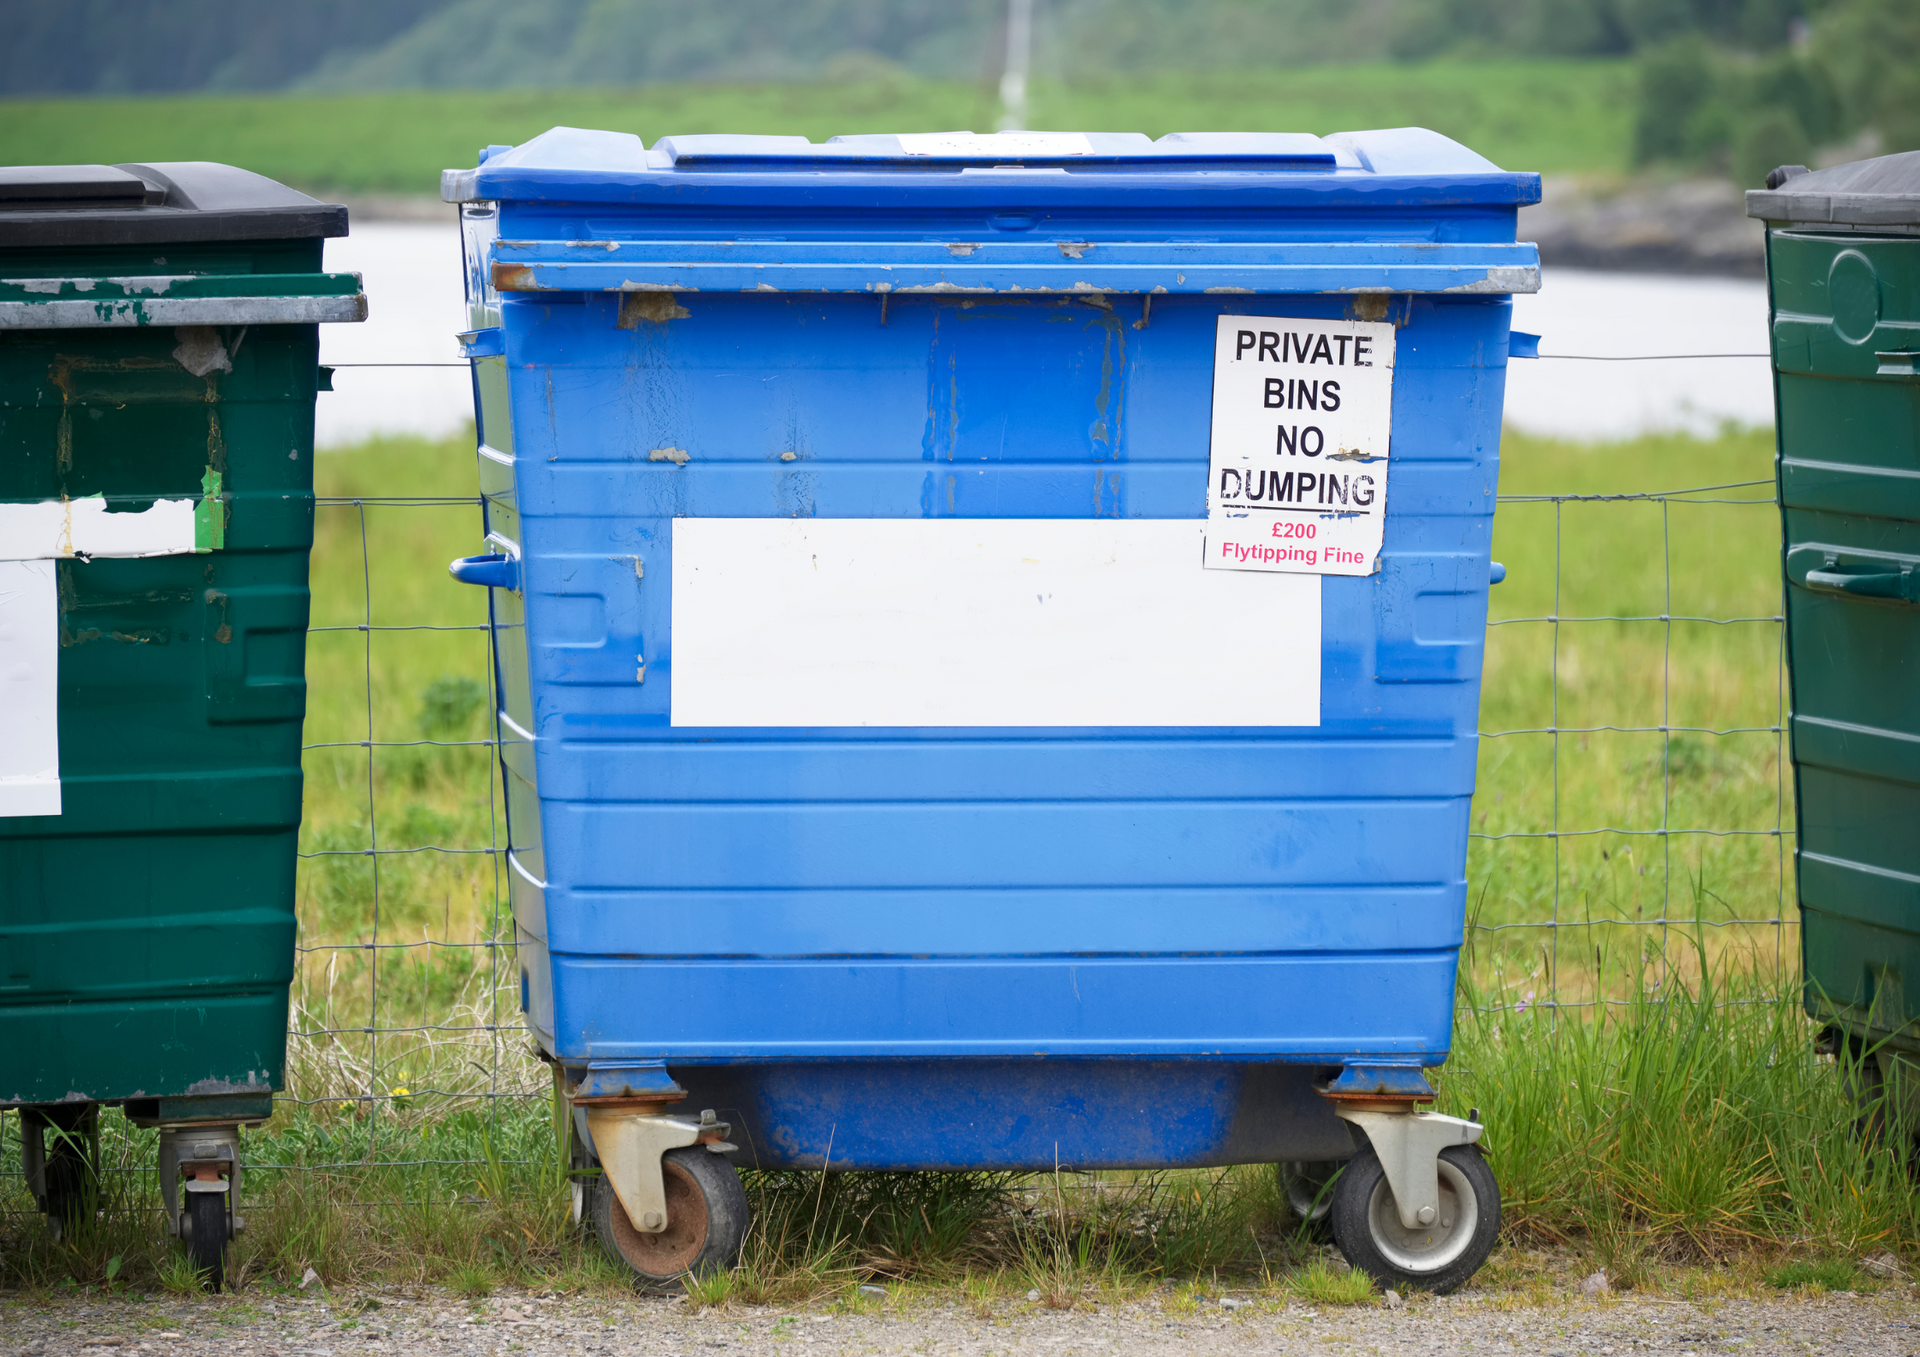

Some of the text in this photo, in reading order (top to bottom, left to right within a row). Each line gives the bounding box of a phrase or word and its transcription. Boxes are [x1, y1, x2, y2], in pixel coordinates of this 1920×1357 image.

[1236, 330, 1373, 366] PRIVATE
[1264, 377, 1341, 412] BINS
[1276, 425, 1324, 457] NO
[1220, 469, 1374, 506] DUMPING
[1272, 522, 1316, 538] £200
[1222, 542, 1364, 565] Flytipping Fine
